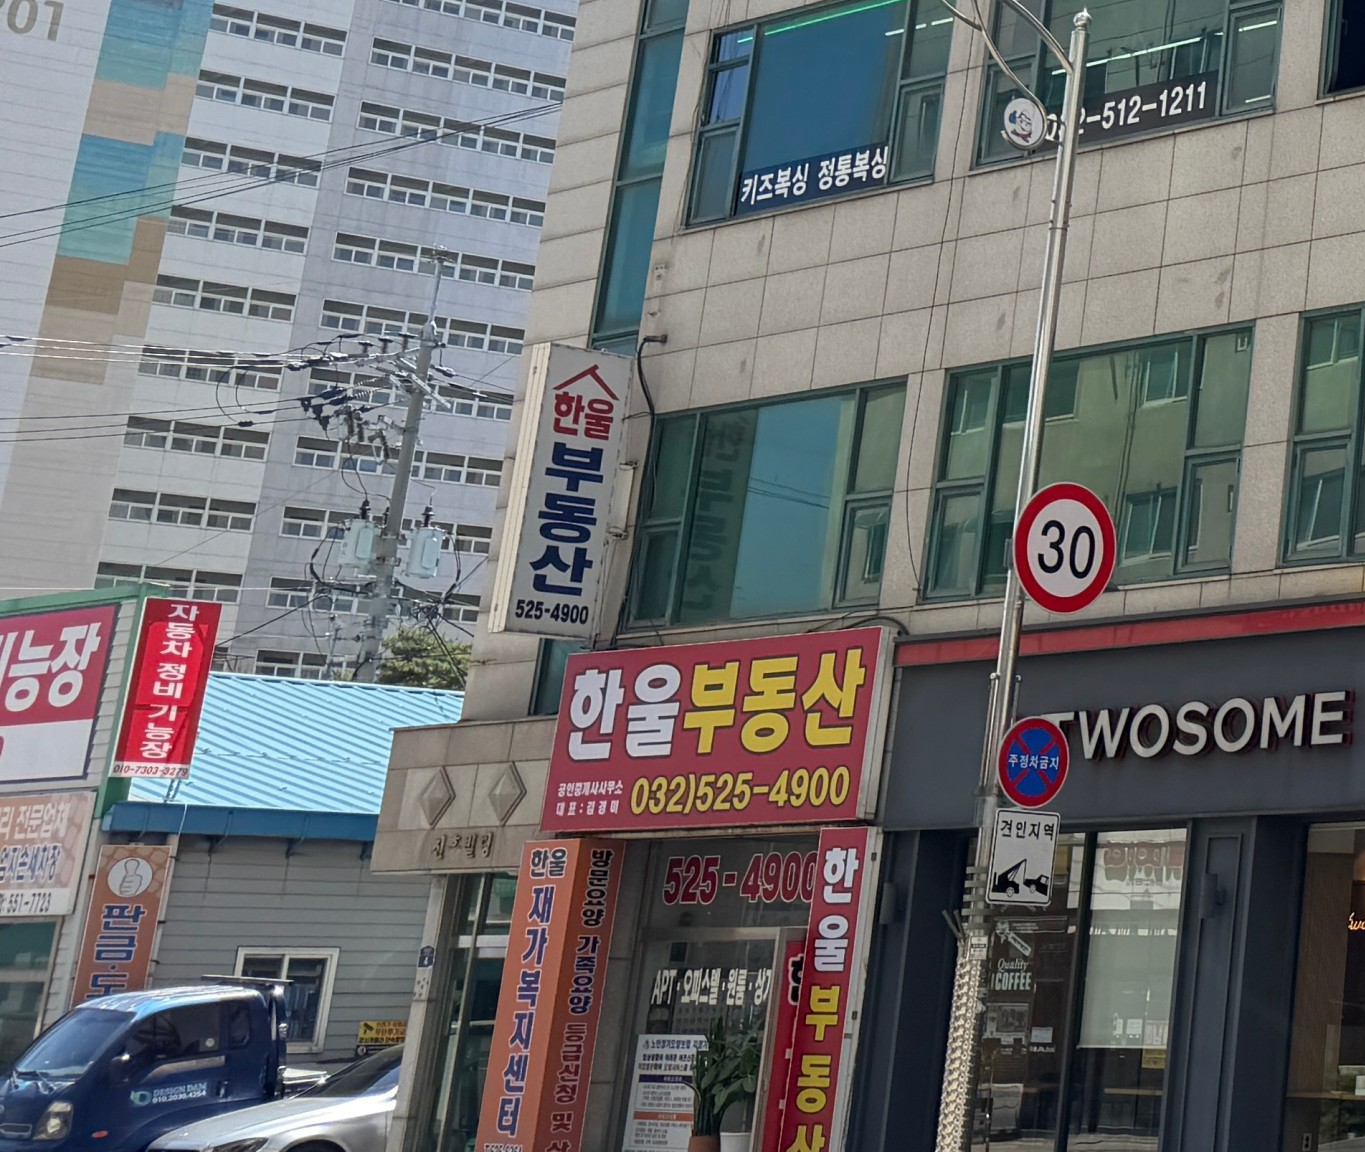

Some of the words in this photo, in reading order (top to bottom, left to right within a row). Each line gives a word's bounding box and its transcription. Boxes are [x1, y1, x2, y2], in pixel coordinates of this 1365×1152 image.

[1045, 81, 1206, 141] 0-512-1211
[740, 160, 809, 206] 키즈복싱
[818, 146, 889, 192] 정통복싱
[553, 392, 614, 441] 한울
[529, 442, 603, 596] 부동산
[1037, 520, 1095, 579] 30
[160, 604, 199, 658] 자동차
[515, 600, 589, 625] 525-4900
[153, 663, 187, 699] 정비
[140, 704, 176, 759] 기능장
[1008, 753, 1059, 770] 주정차금지
[558, 780, 623, 797] 공인중개사사무소
[630, 766, 850, 815] 032)525-4900
[1000, 819, 1055, 841] 견인지역
[530, 848, 567, 879] 한울
[567, 935, 600, 1016] 가족요양
[652, 969, 676, 1004] APT
[681, 968, 721, 1005] 오피스텔
[726, 968, 748, 1006] 원룸
[995, 972, 1032, 990] COFFEE
[997, 957, 1029, 972] Quality
[497, 885, 556, 1137] 재가복지센터
[554, 1022, 587, 1104] 등급신청
